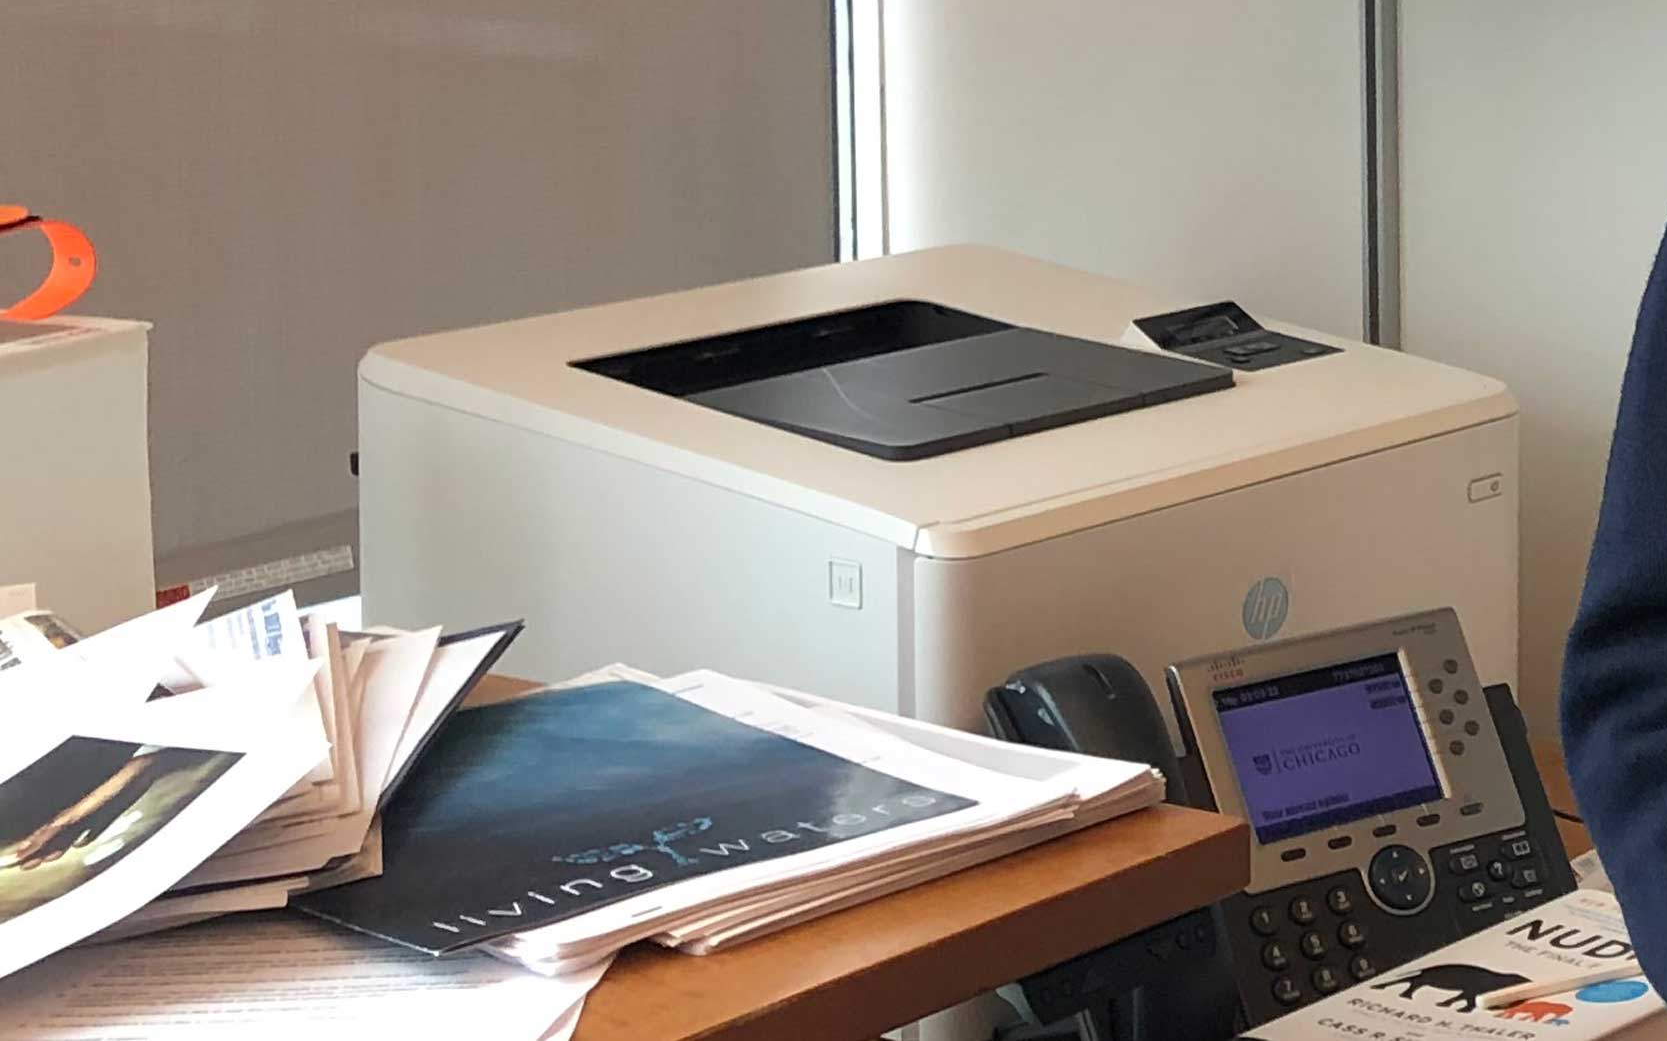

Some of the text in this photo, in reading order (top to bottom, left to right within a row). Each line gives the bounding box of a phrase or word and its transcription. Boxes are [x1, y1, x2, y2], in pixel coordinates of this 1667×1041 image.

[1248, 577, 1285, 640] hp
[1282, 743, 1361, 772] CHICAGO
[702, 791, 938, 859] waters
[431, 862, 655, 935] living
[1505, 940, 1586, 967] THE FINAL
[1317, 1018, 1368, 1037] CASS
[1347, 997, 1536, 1041] RICHARD THALER
